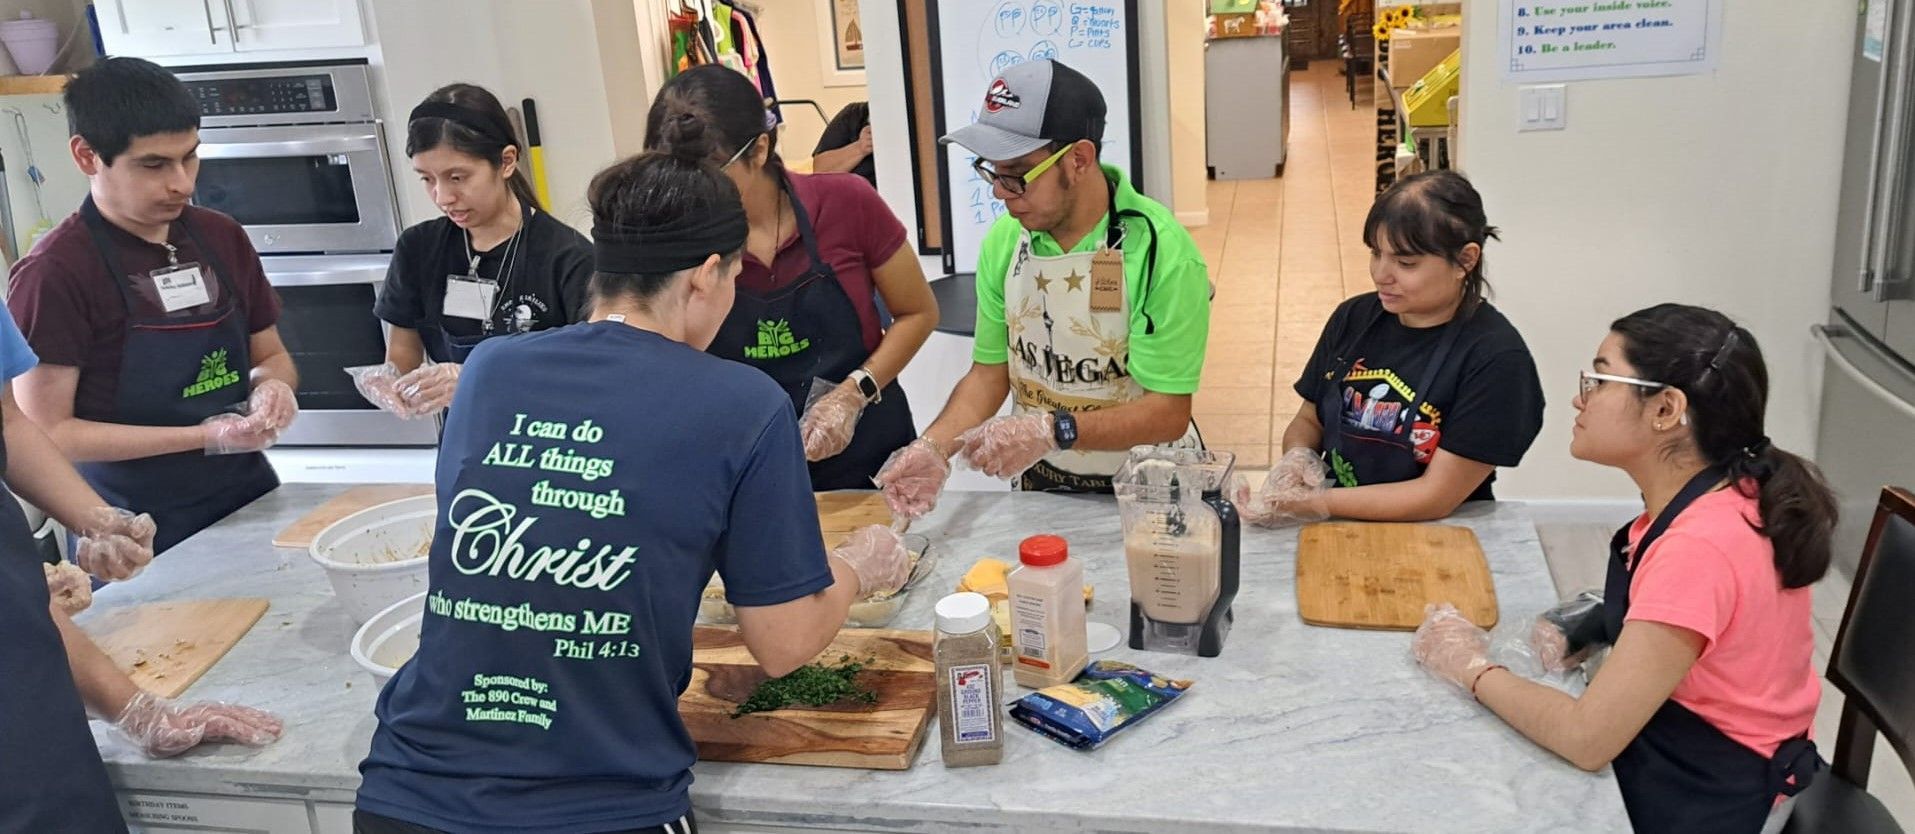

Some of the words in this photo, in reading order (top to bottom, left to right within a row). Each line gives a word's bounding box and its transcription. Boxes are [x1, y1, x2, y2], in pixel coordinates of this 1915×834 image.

[1518, 7, 1530, 17] 8.
[1535, 5, 1556, 16] Use
[1560, 6, 1589, 17] your
[1593, 1, 1632, 12] inside
[1636, 0, 1672, 9] voice.
[1517, 26, 1529, 36] 9.
[1534, 24, 1566, 36] Keep
[1569, 24, 1599, 35] your
[1603, 22, 1631, 31] area
[1635, 18, 1674, 28] clean.
[1518, 44, 1537, 55] 10.
[1542, 43, 1559, 53] Be
[1562, 44, 1570, 52] a
[1574, 40, 1617, 52] leader.
[744, 337, 810, 359] HEROES
[183, 370, 240, 398] HEROES
[509, 413, 527, 436] I
[527, 420, 567, 439] can
[572, 420, 603, 443] do
[482, 441, 535, 468] ALL
[539, 447, 614, 481] things
[531, 480, 626, 519] through
[448, 488, 640, 591] Christ
[429, 589, 452, 617] who
[454, 597, 576, 631] strengthens
[580, 610, 632, 634] ME
[553, 638, 594, 659] Phil
[598, 641, 640, 658] 4:13
[474, 673, 529, 690] Sponsored
[532, 679, 548, 693] by:
[461, 691, 486, 702] The
[488, 690, 510, 702] 890
[511, 692, 537, 707] Crew
[539, 700, 557, 711] and
[466, 708, 517, 722] Martinez
[518, 709, 552, 730] Family
